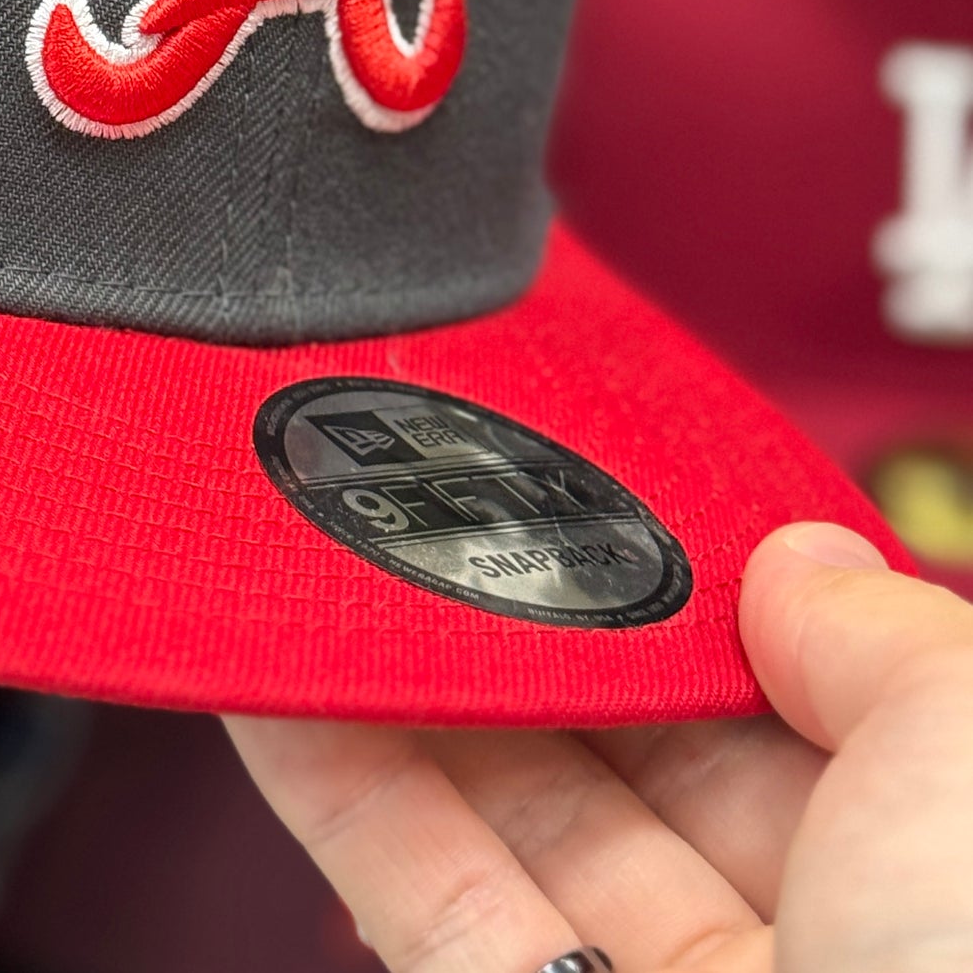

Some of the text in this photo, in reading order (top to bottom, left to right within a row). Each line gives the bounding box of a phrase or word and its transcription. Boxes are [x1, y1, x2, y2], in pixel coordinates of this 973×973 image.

[392, 414, 450, 434] NEW
[411, 430, 468, 448] ERA
[341, 470, 586, 532] 9FIFTY
[468, 543, 633, 578] SNAPBACK
